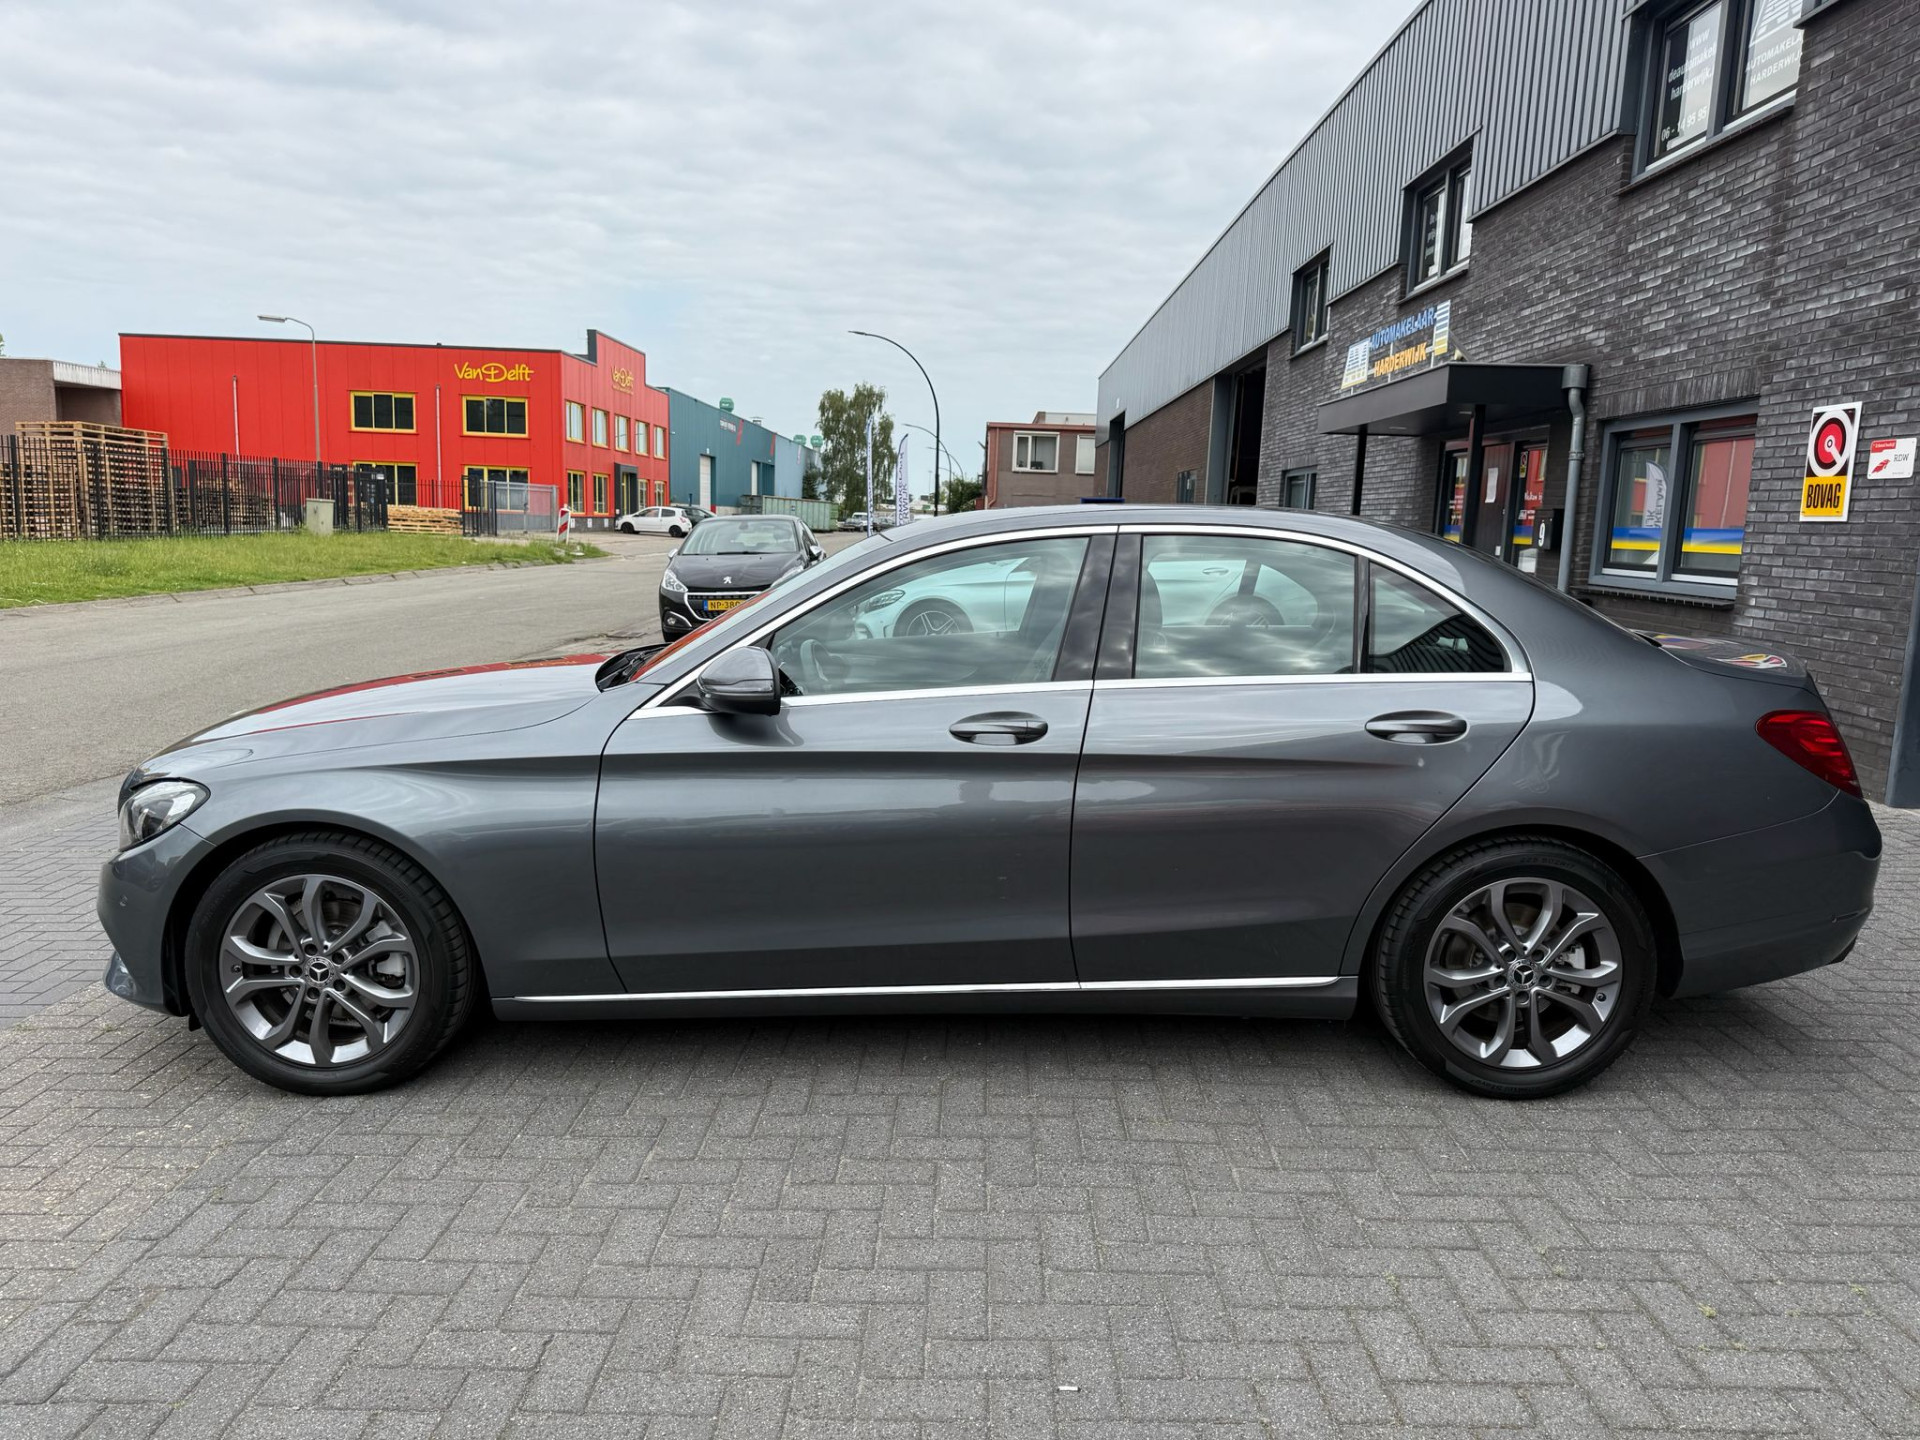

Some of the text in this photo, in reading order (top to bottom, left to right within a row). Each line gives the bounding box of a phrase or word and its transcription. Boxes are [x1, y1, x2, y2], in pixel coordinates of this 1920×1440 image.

[1750, 51, 1803, 89] HARDERWIJ
[1369, 306, 1434, 350] AUTOMAKELAAR
[1374, 342, 1427, 377] HARDERWIJK
[1806, 483, 1842, 509] BOVAG
[1538, 522, 1546, 547] 9
